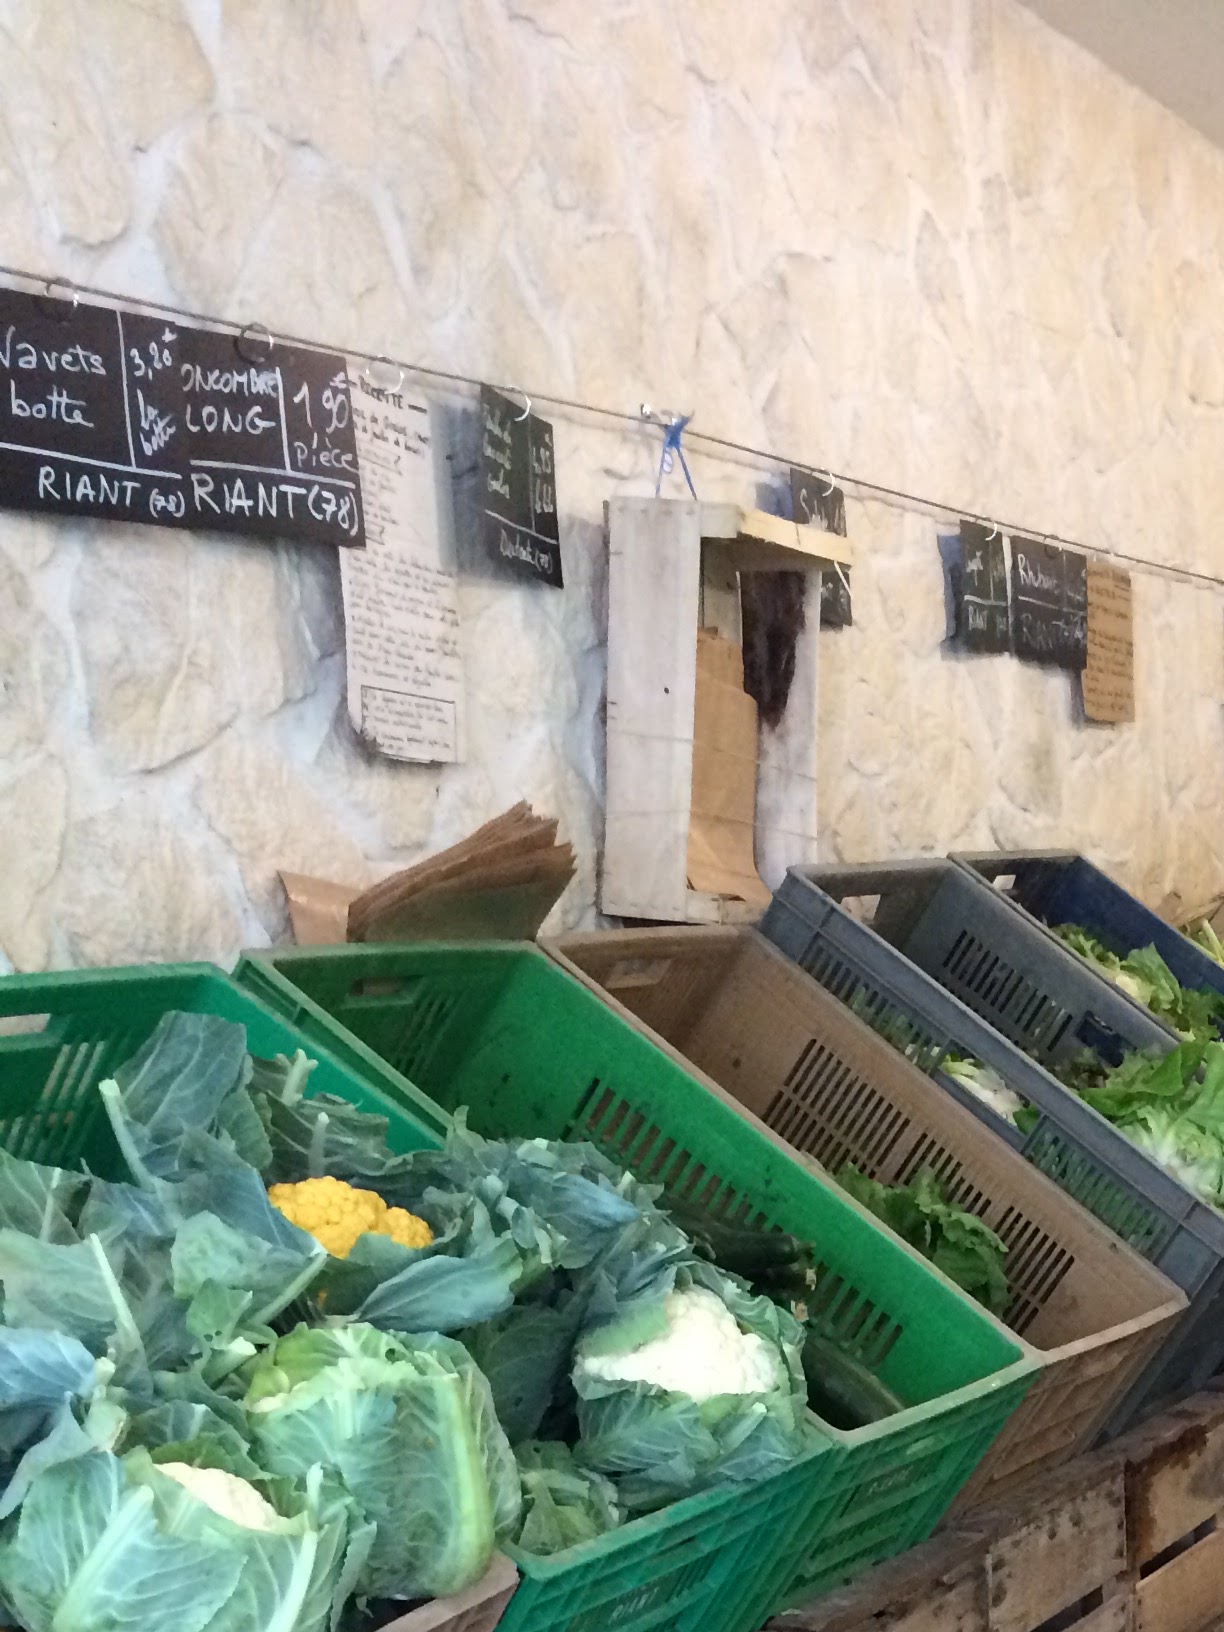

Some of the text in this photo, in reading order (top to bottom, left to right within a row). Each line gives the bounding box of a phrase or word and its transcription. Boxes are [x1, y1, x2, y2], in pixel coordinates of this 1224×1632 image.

[10, 379, 94, 428] botte
[185, 404, 276, 435] LONG
[38, 465, 141, 507] RIANT
